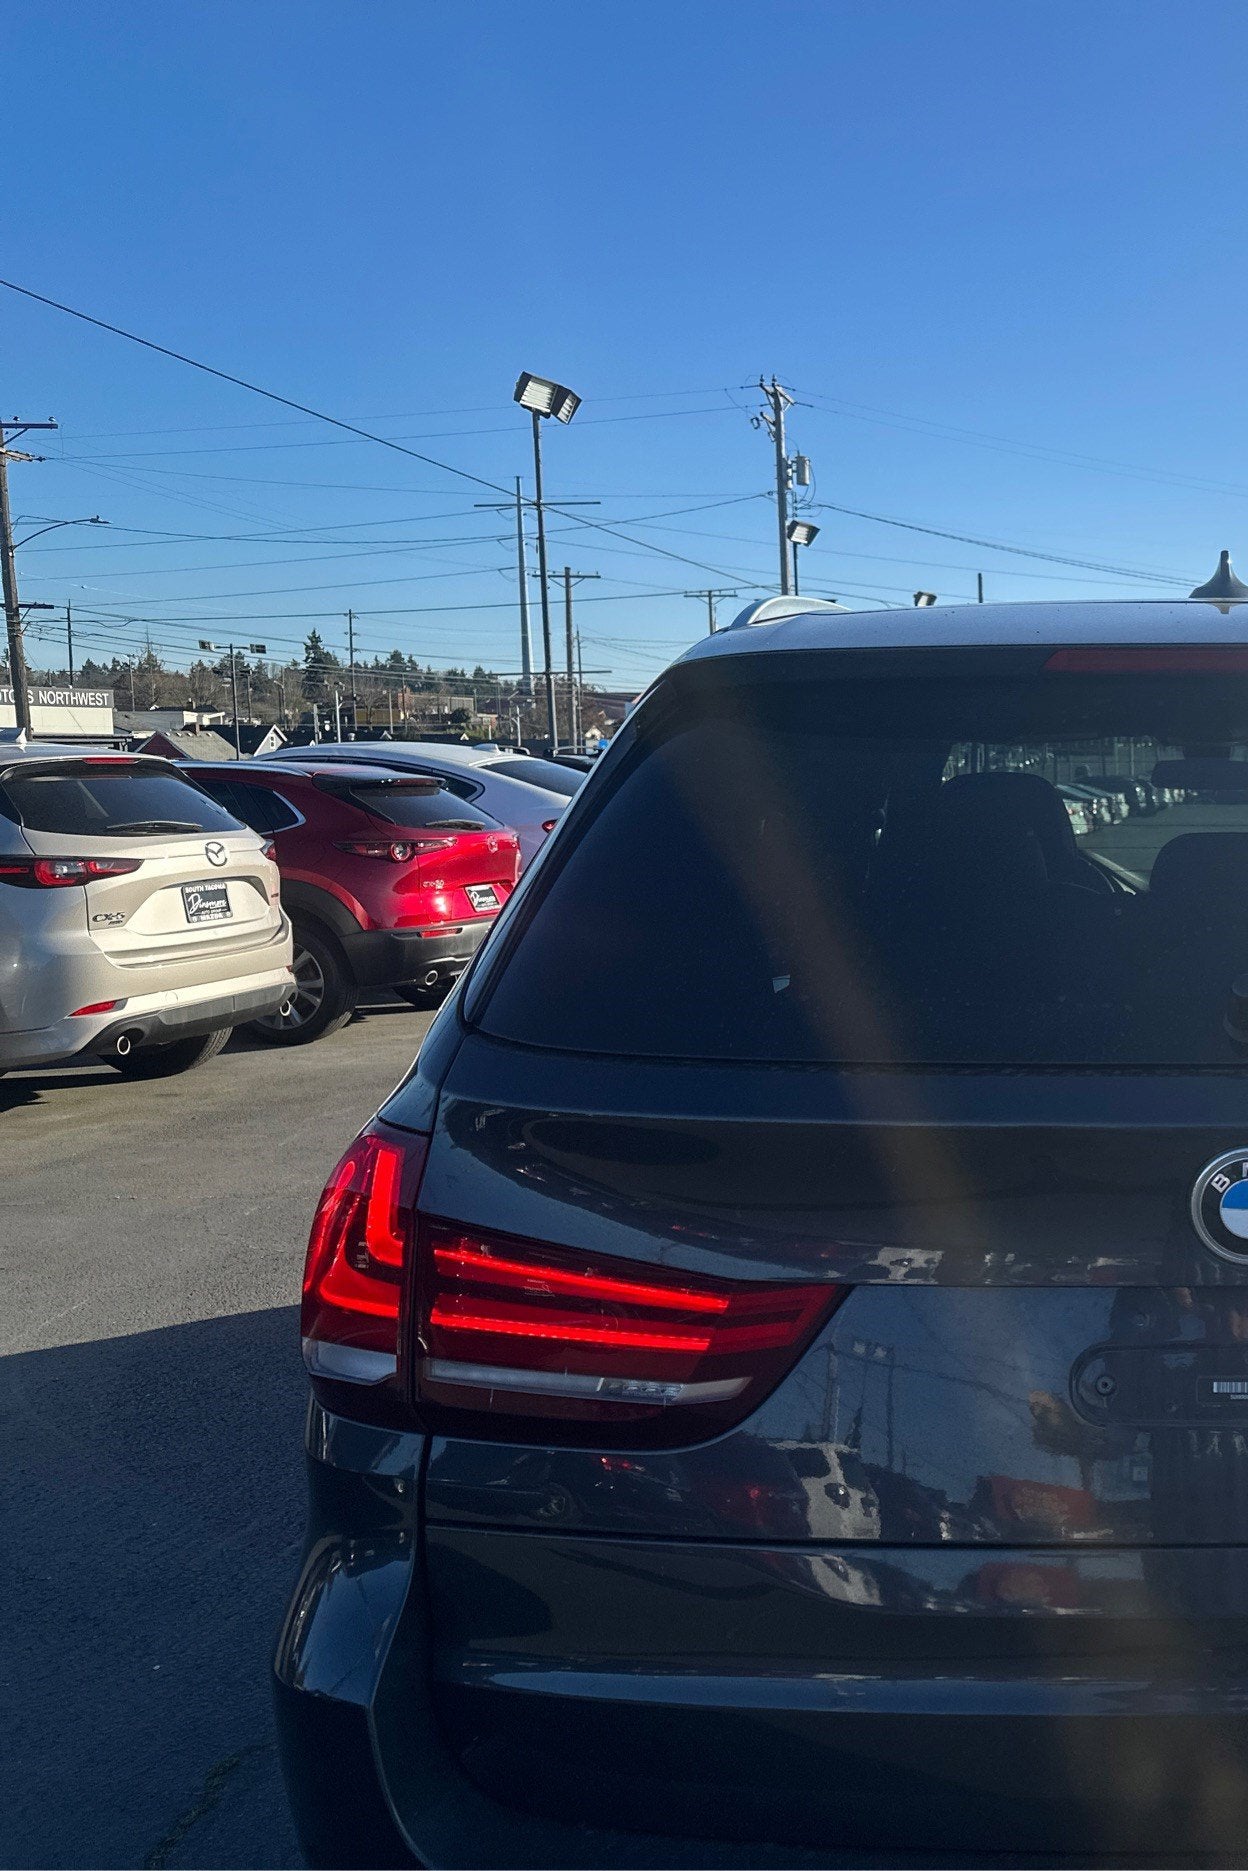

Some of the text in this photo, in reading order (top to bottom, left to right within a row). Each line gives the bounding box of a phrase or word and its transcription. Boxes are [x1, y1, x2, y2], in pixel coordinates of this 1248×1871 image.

[39, 691, 109, 705] NORTHWEST
[185, 885, 204, 893] SOUTH
[92, 911, 125, 922] CX-5
